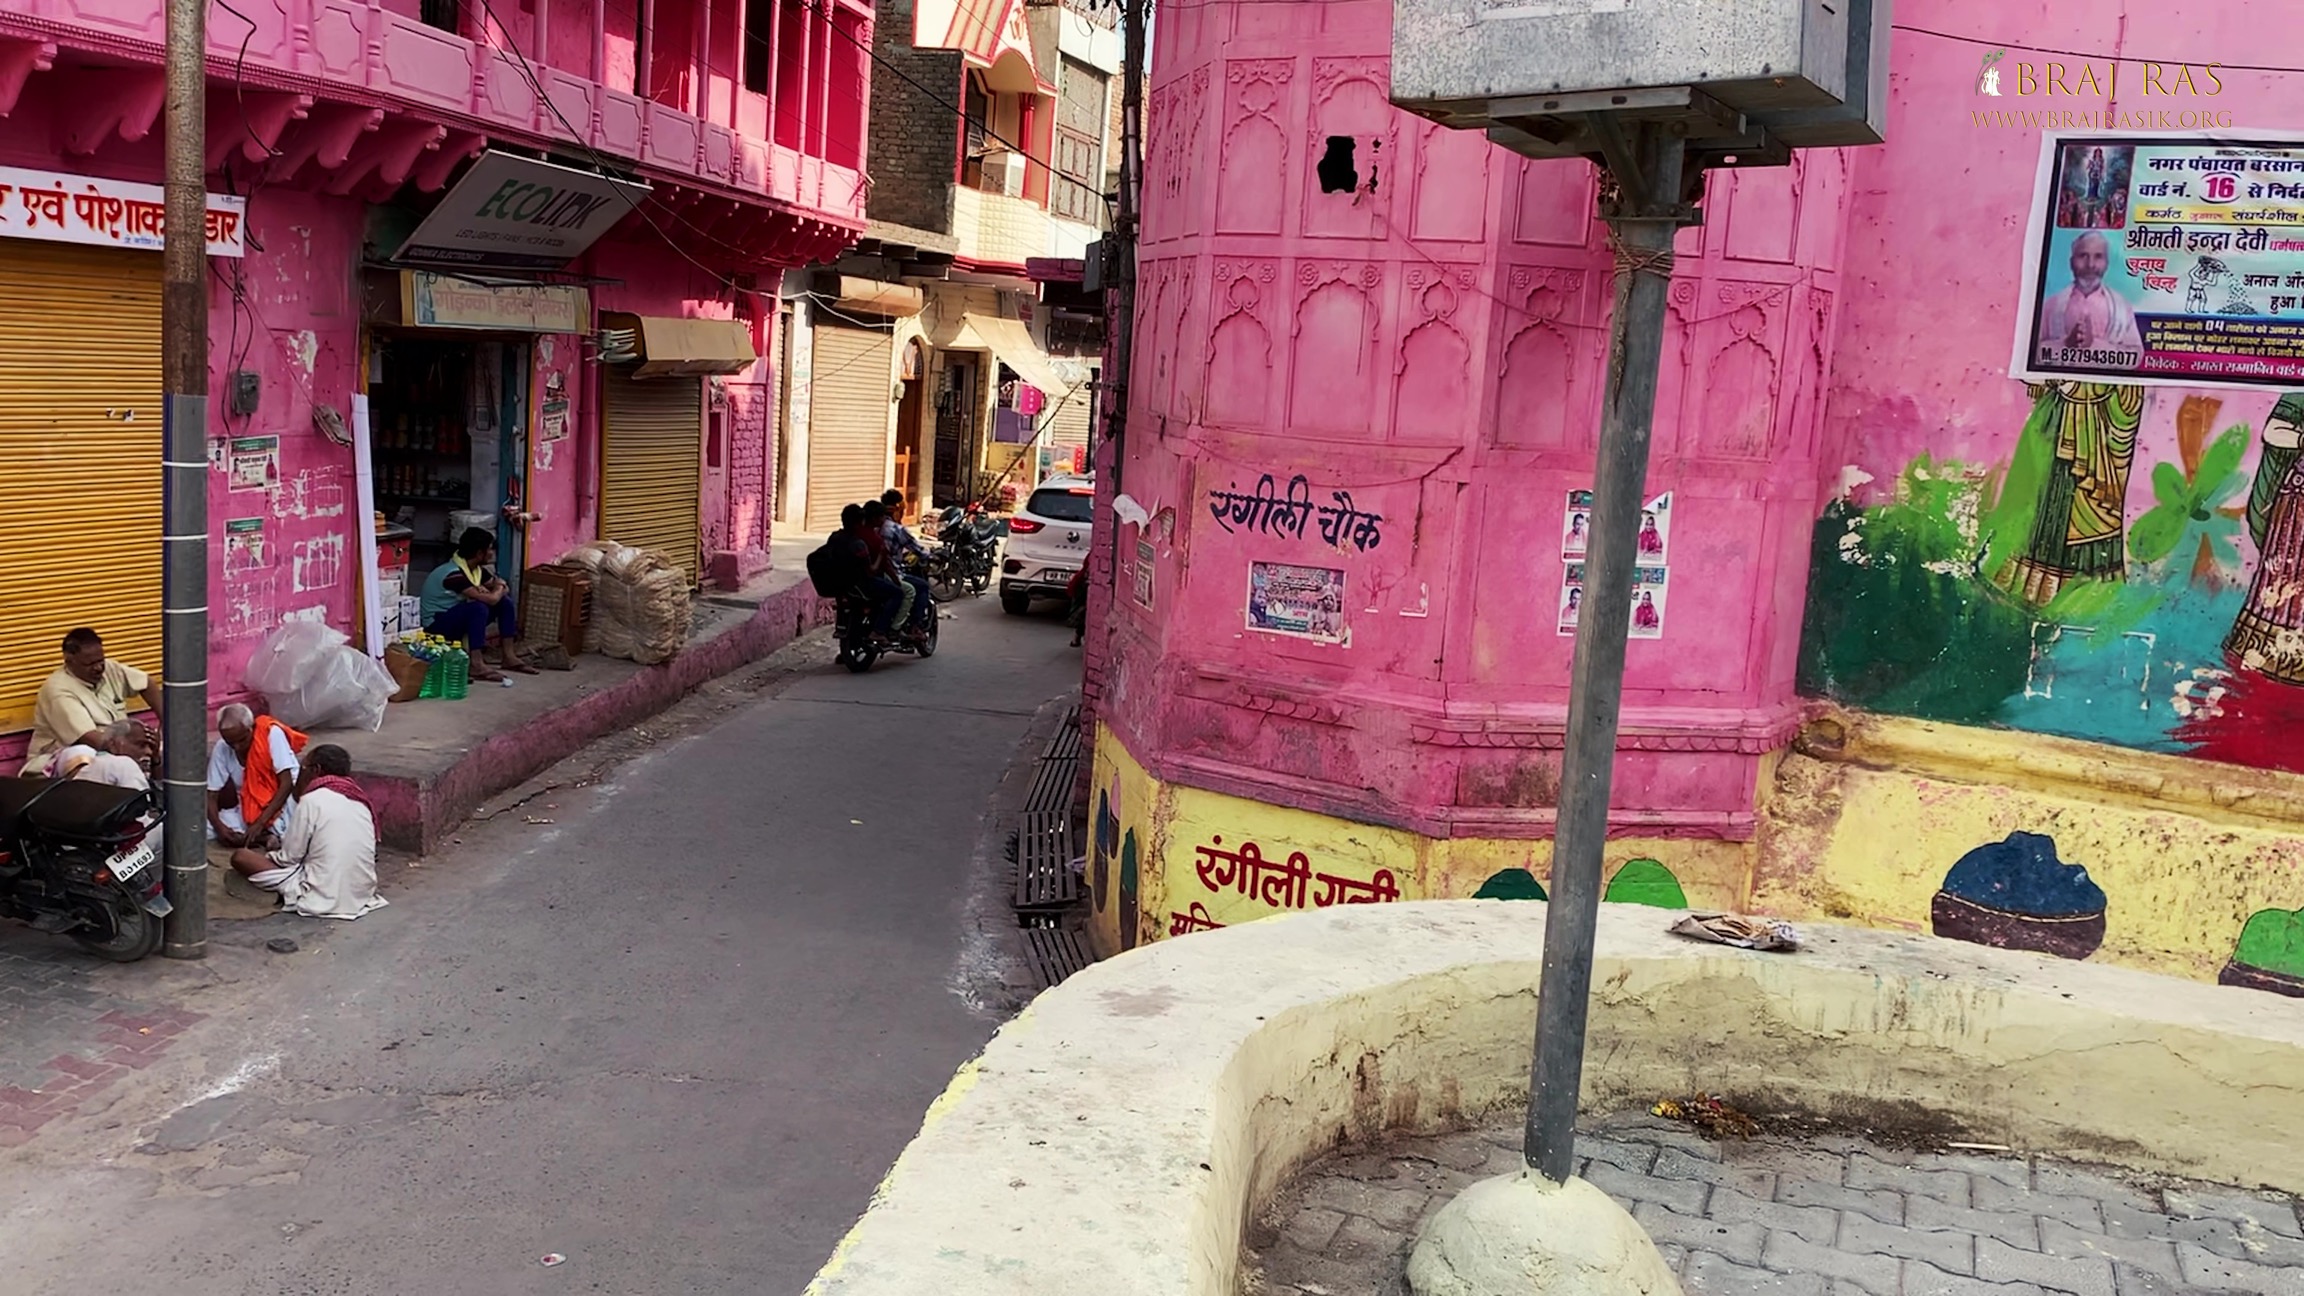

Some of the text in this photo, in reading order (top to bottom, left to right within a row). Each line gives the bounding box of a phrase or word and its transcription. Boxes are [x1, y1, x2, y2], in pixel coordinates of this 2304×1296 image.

[2149, 158, 2185, 171] नगर
[2189, 155, 2246, 172] पंचायत
[2139, 181, 2169, 197] वार्ड
[2205, 177, 2236, 199] 16
[2247, 182, 2264, 198] से
[19, 180, 68, 229] एवं
[206, 208, 240, 246] डार
[474, 178, 612, 230] ECOLINK
[2127, 225, 2184, 249] श्रीमती
[2187, 231, 2231, 252] इन्द्रा
[2236, 228, 2269, 251] देवी
[2127, 258, 2166, 274] चुनाव
[2145, 273, 2178, 292] चिन्ह
[2242, 274, 2279, 288] अनाज
[2270, 296, 2296, 314] हुआ
[2205, 320, 2225, 332] 04
[2061, 348, 2138, 366] 8279436077
[2225, 360, 2273, 375] सम्मानित
[1210, 474, 1383, 553] रंगीली चौक
[1195, 835, 1312, 909] रंगीली
